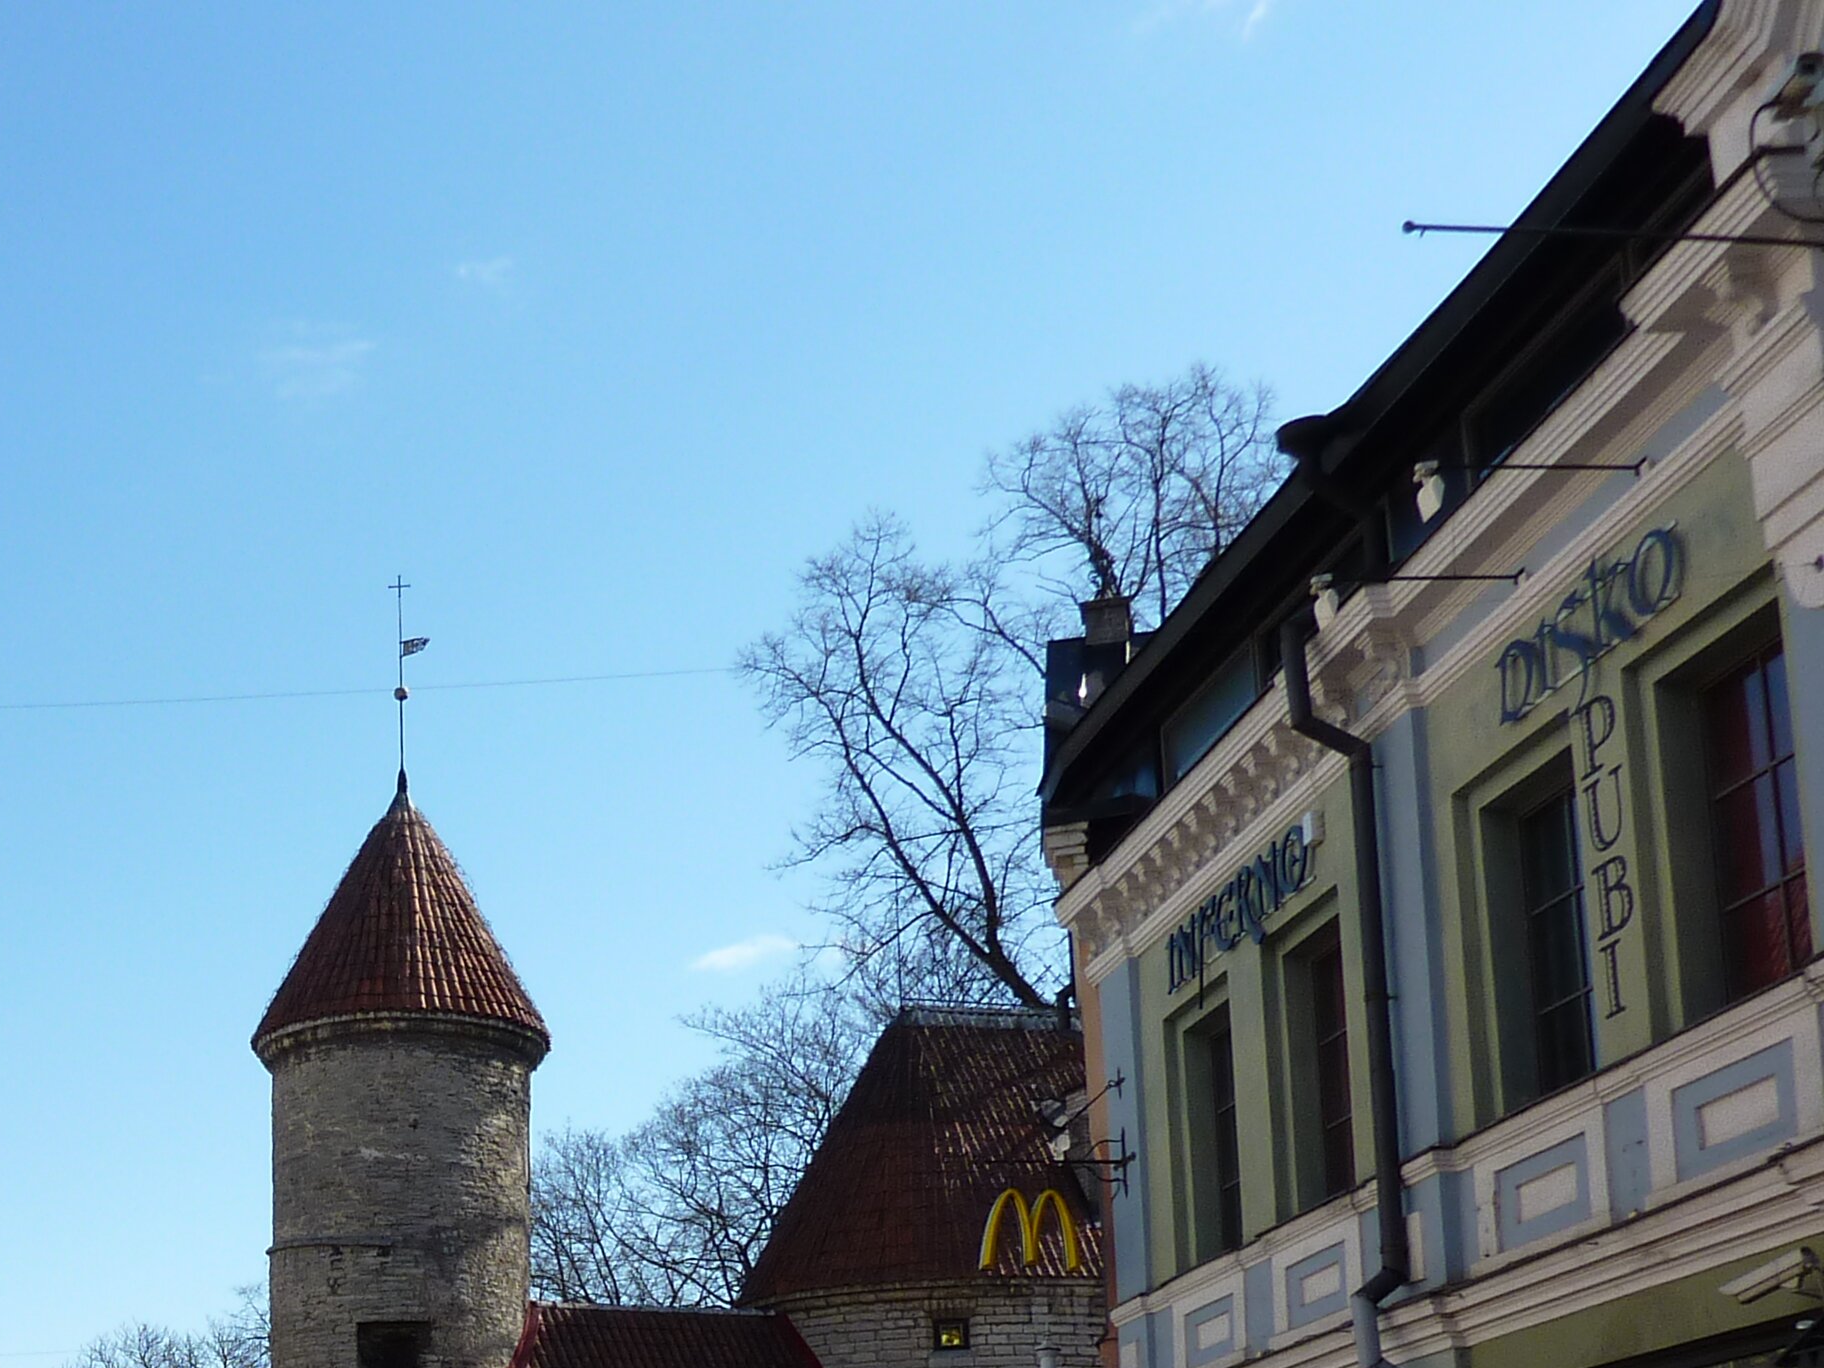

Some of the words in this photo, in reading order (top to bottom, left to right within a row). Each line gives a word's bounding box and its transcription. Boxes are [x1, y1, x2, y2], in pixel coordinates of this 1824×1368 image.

[1494, 527, 1676, 726] DISKO
[1166, 824, 1308, 1010] INFERNO
[1576, 695, 1634, 1020] PUBI
